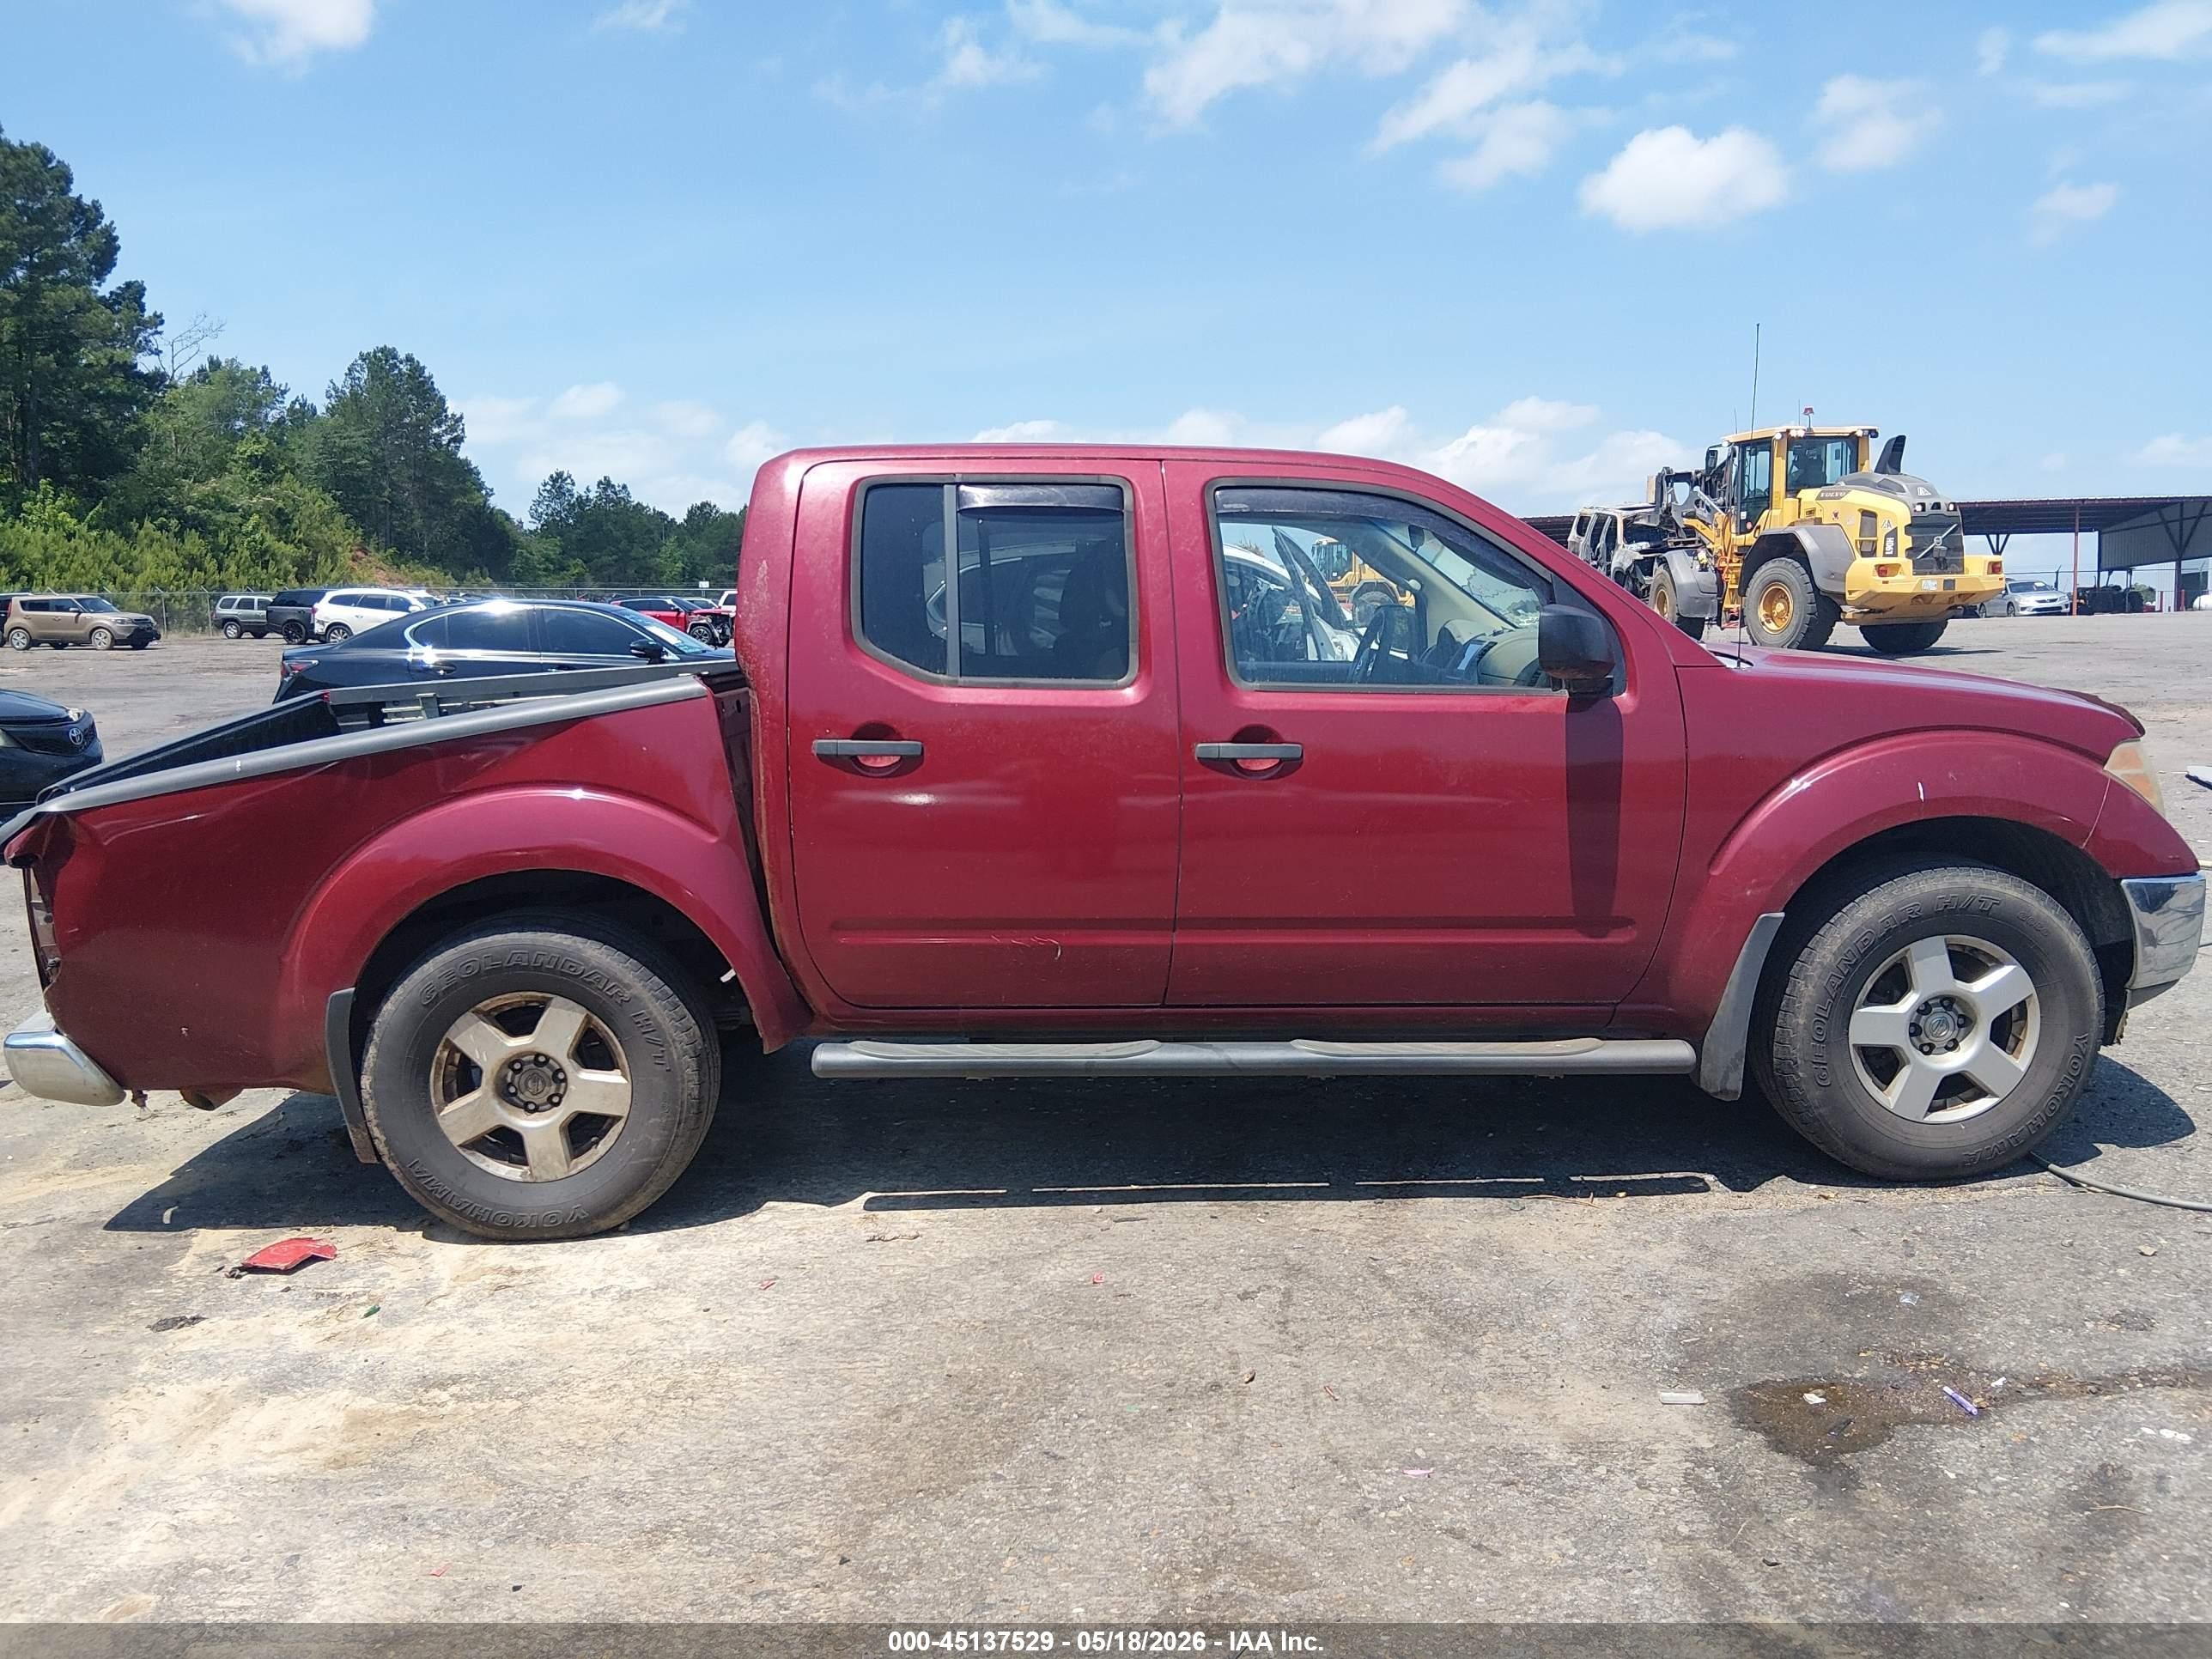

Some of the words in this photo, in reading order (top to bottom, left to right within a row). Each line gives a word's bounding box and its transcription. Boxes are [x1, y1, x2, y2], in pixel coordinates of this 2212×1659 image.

[419, 950, 631, 1006] GEOLANDAR
[1811, 902, 1924, 1088] GEOLANDAR
[1933, 895, 2001, 913] H/T
[1961, 1033, 2089, 1166] YOKOHAMA
[406, 1158, 590, 1228] YOKOHAMA
